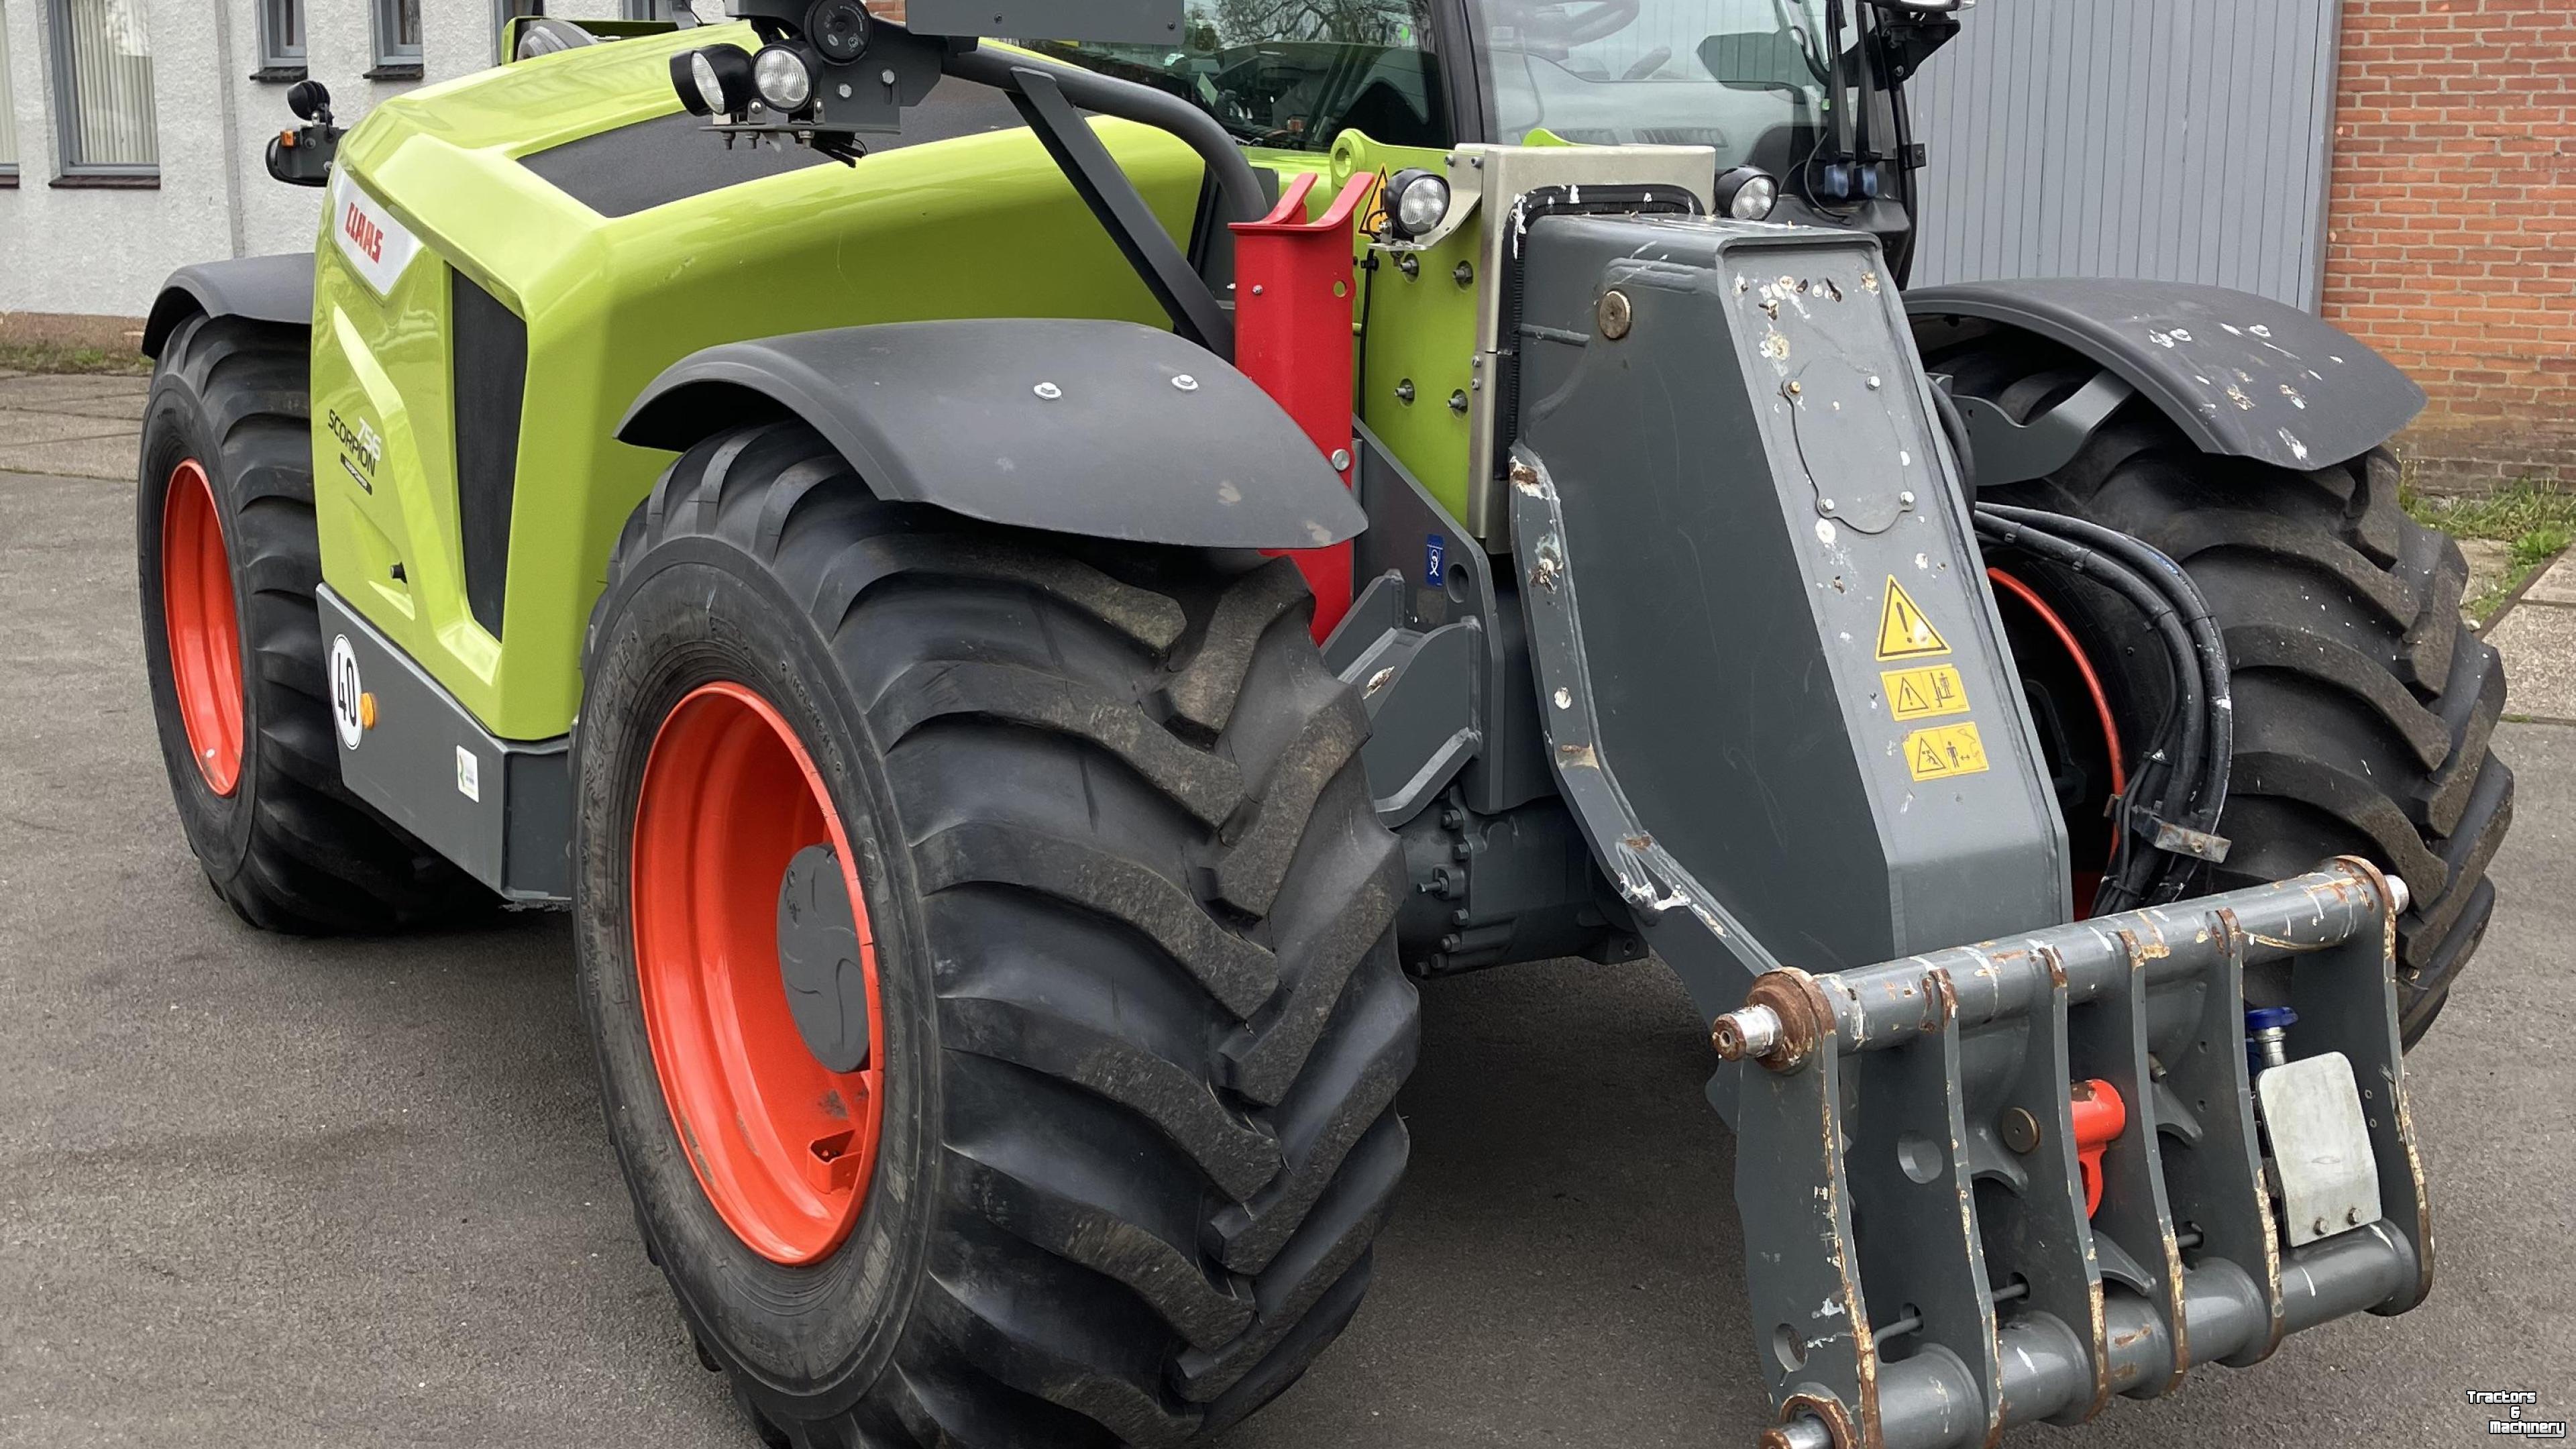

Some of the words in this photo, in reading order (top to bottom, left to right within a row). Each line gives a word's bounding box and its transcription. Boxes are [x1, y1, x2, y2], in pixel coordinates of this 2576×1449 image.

[345, 202, 383, 264] CLAAS
[328, 409, 376, 477] SCORPION
[357, 416, 382, 462] 756
[338, 652, 356, 727] 40
